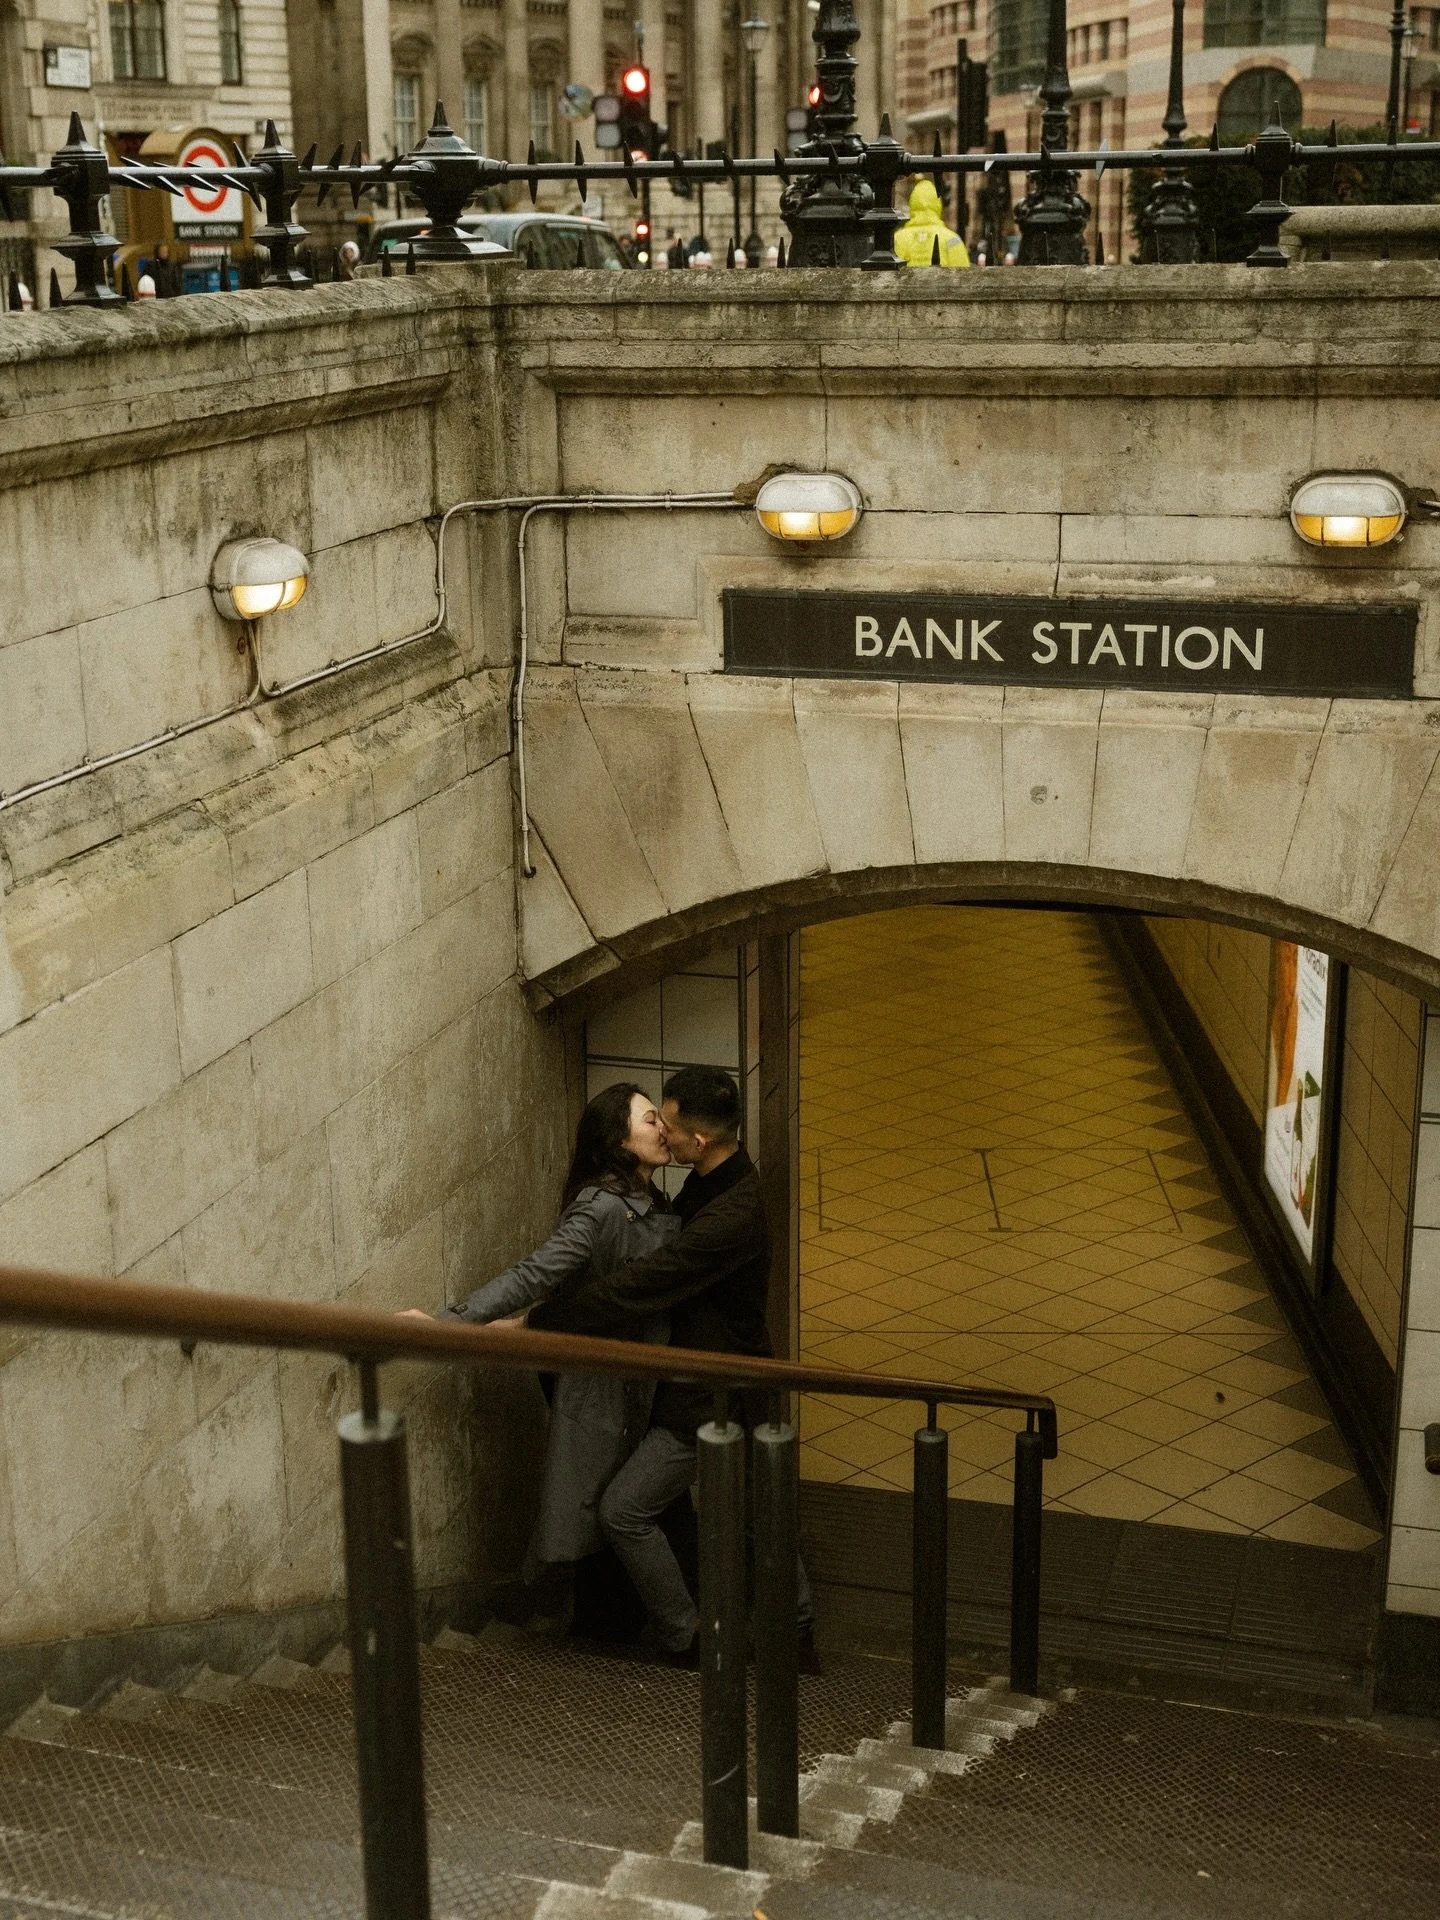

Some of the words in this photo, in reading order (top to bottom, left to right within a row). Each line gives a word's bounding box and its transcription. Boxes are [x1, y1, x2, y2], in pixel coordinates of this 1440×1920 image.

[179, 225, 201, 238] BANK
[204, 224, 239, 238] STATION
[855, 615, 1005, 662] BANK
[1031, 621, 1264, 671] STATION
